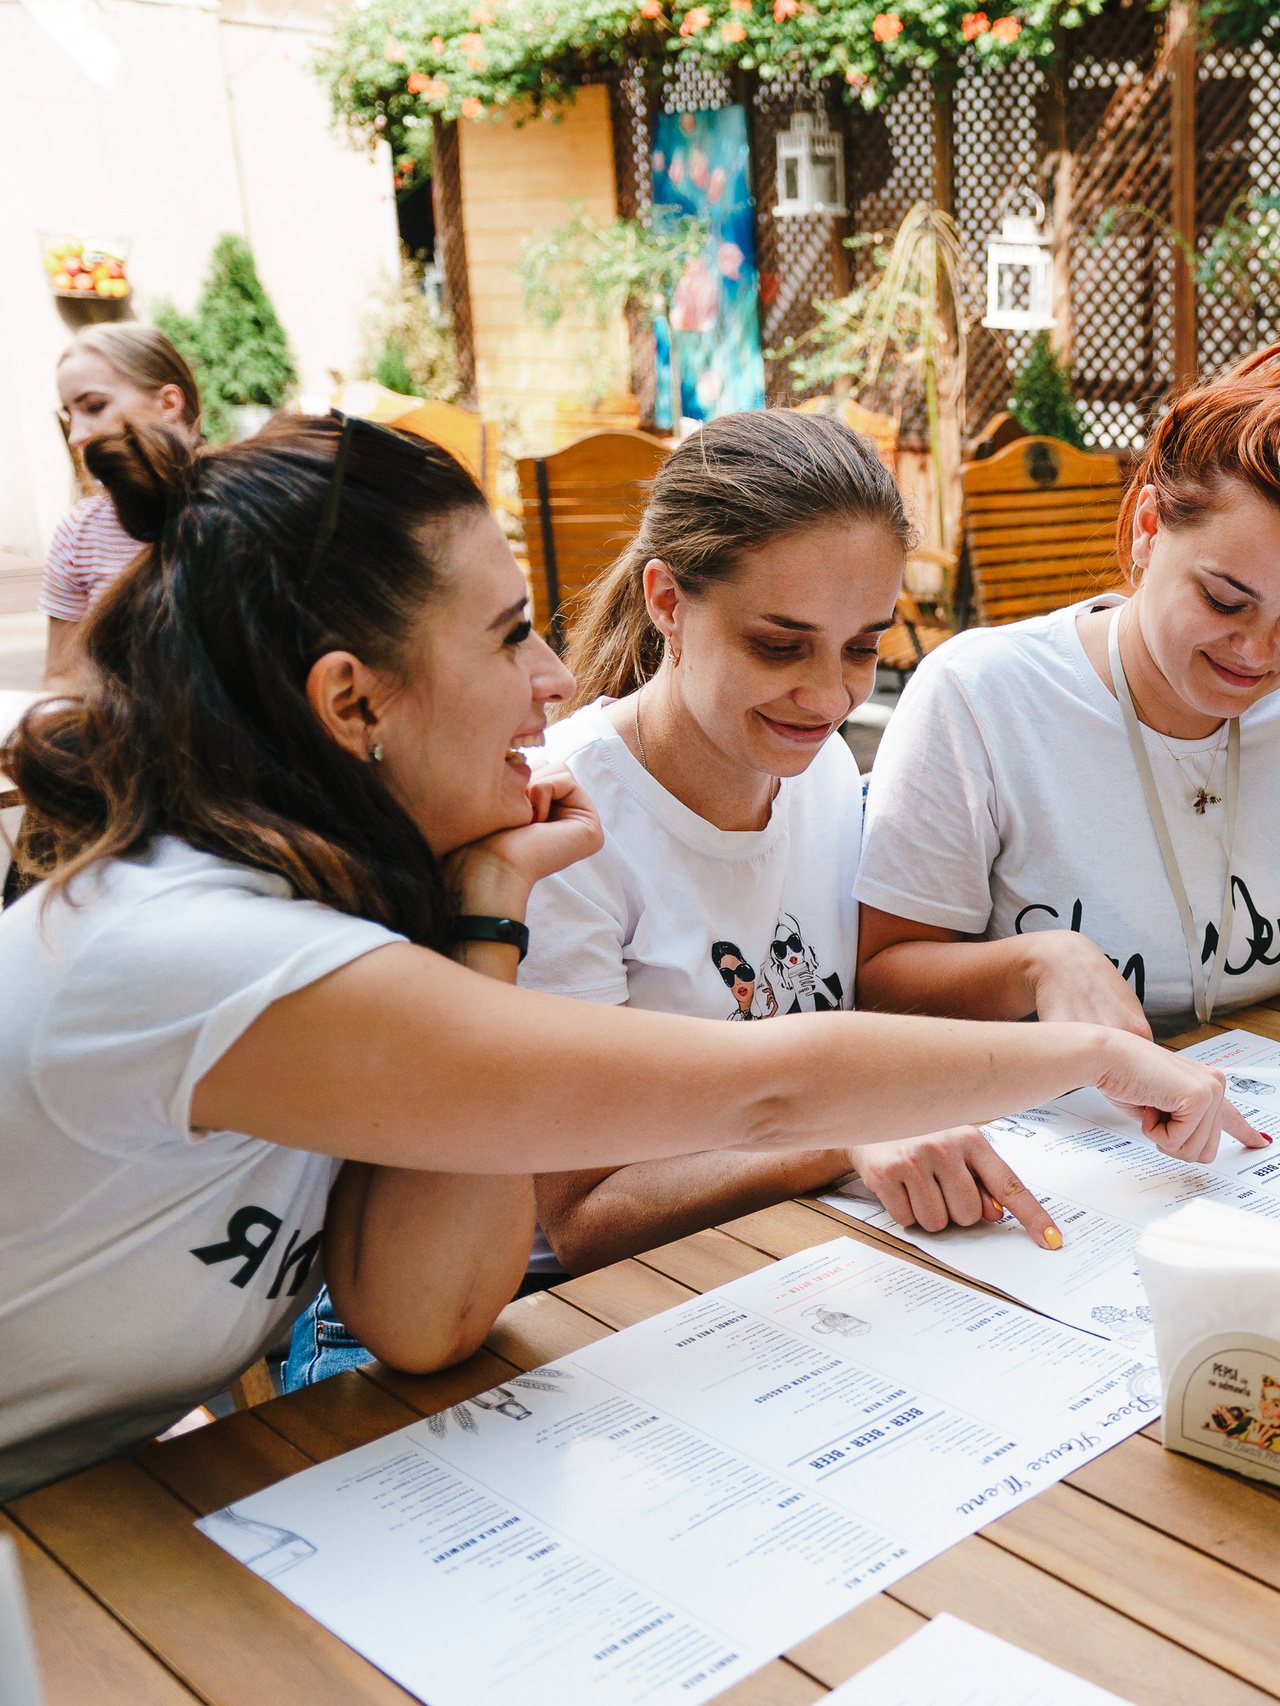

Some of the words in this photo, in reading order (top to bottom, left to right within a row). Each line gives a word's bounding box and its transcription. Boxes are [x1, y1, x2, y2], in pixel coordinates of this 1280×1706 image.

[1252, 1164, 1279, 1177] BEER
[808, 1266, 844, 1282] SPECIAL
[788, 1281, 813, 1294] OFFER
[714, 1314, 748, 1330] ALCOHOL
[966, 1318, 992, 1332] COFFEE
[675, 1337, 696, 1348] BEER
[810, 1360, 843, 1376] BOTTLED
[790, 1374, 811, 1386] BEER
[1095, 1380, 1119, 1395] SOFTS
[754, 1384, 792, 1404] CLASSICS
[882, 1389, 907, 1403] DRAFT
[862, 1402, 883, 1414] BEER
[1068, 1397, 1093, 1411] WATER
[1097, 1395, 1159, 1428] Beer
[630, 1416, 660, 1430] WHEAT
[890, 1408, 924, 1427] BEER
[608, 1428, 630, 1440] BEER
[850, 1428, 886, 1448] BEER
[809, 1449, 846, 1469] BEER
[1026, 1432, 1101, 1471] House
[777, 1492, 804, 1508] LAGER
[956, 1475, 1032, 1515] Menu
[478, 1516, 520, 1540] HOPLALA
[433, 1538, 478, 1564] BREWERY
[620, 1612, 674, 1645] FLAVOURED
[594, 1644, 620, 1661] BEER
[681, 1672, 708, 1690] BEER
